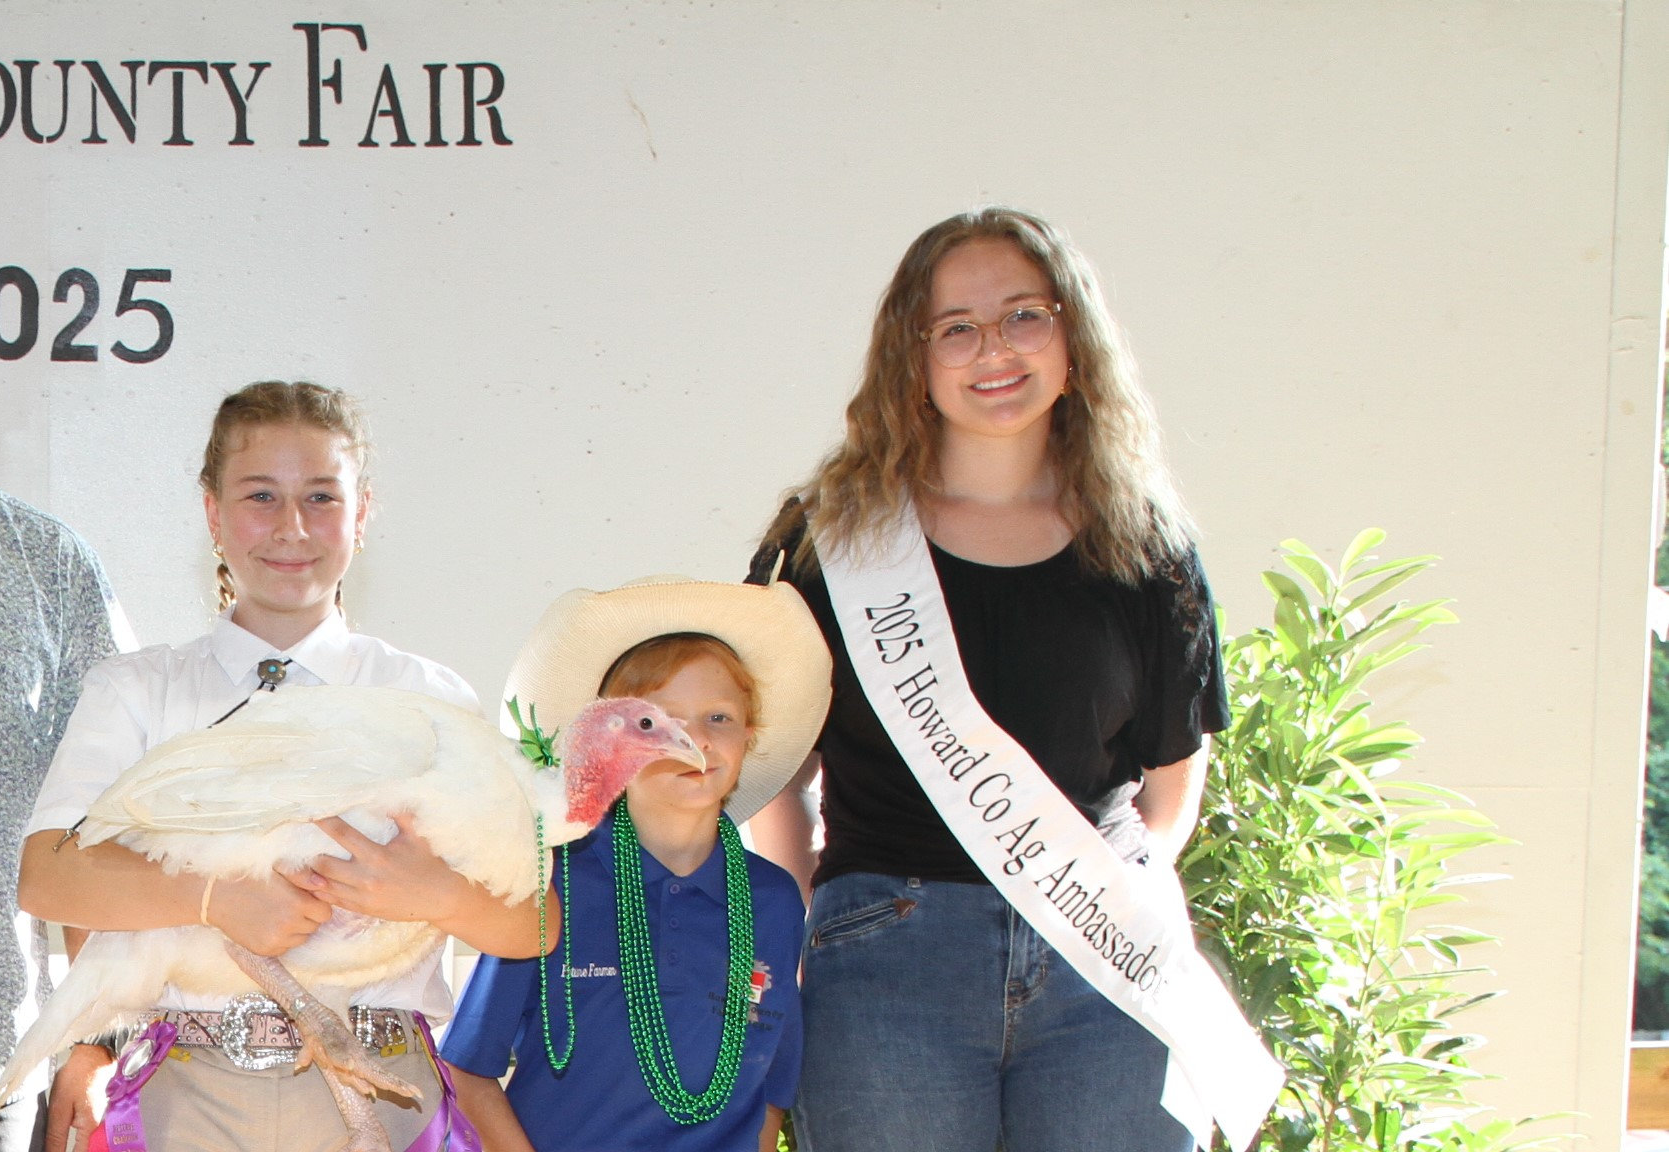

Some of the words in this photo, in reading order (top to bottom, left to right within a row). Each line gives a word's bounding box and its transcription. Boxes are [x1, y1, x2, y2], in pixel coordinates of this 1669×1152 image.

[864, 592, 924, 665] 2025
[892, 662, 991, 782] Howard
[969, 773, 1014, 822] Co
[994, 816, 1046, 875] Ag
